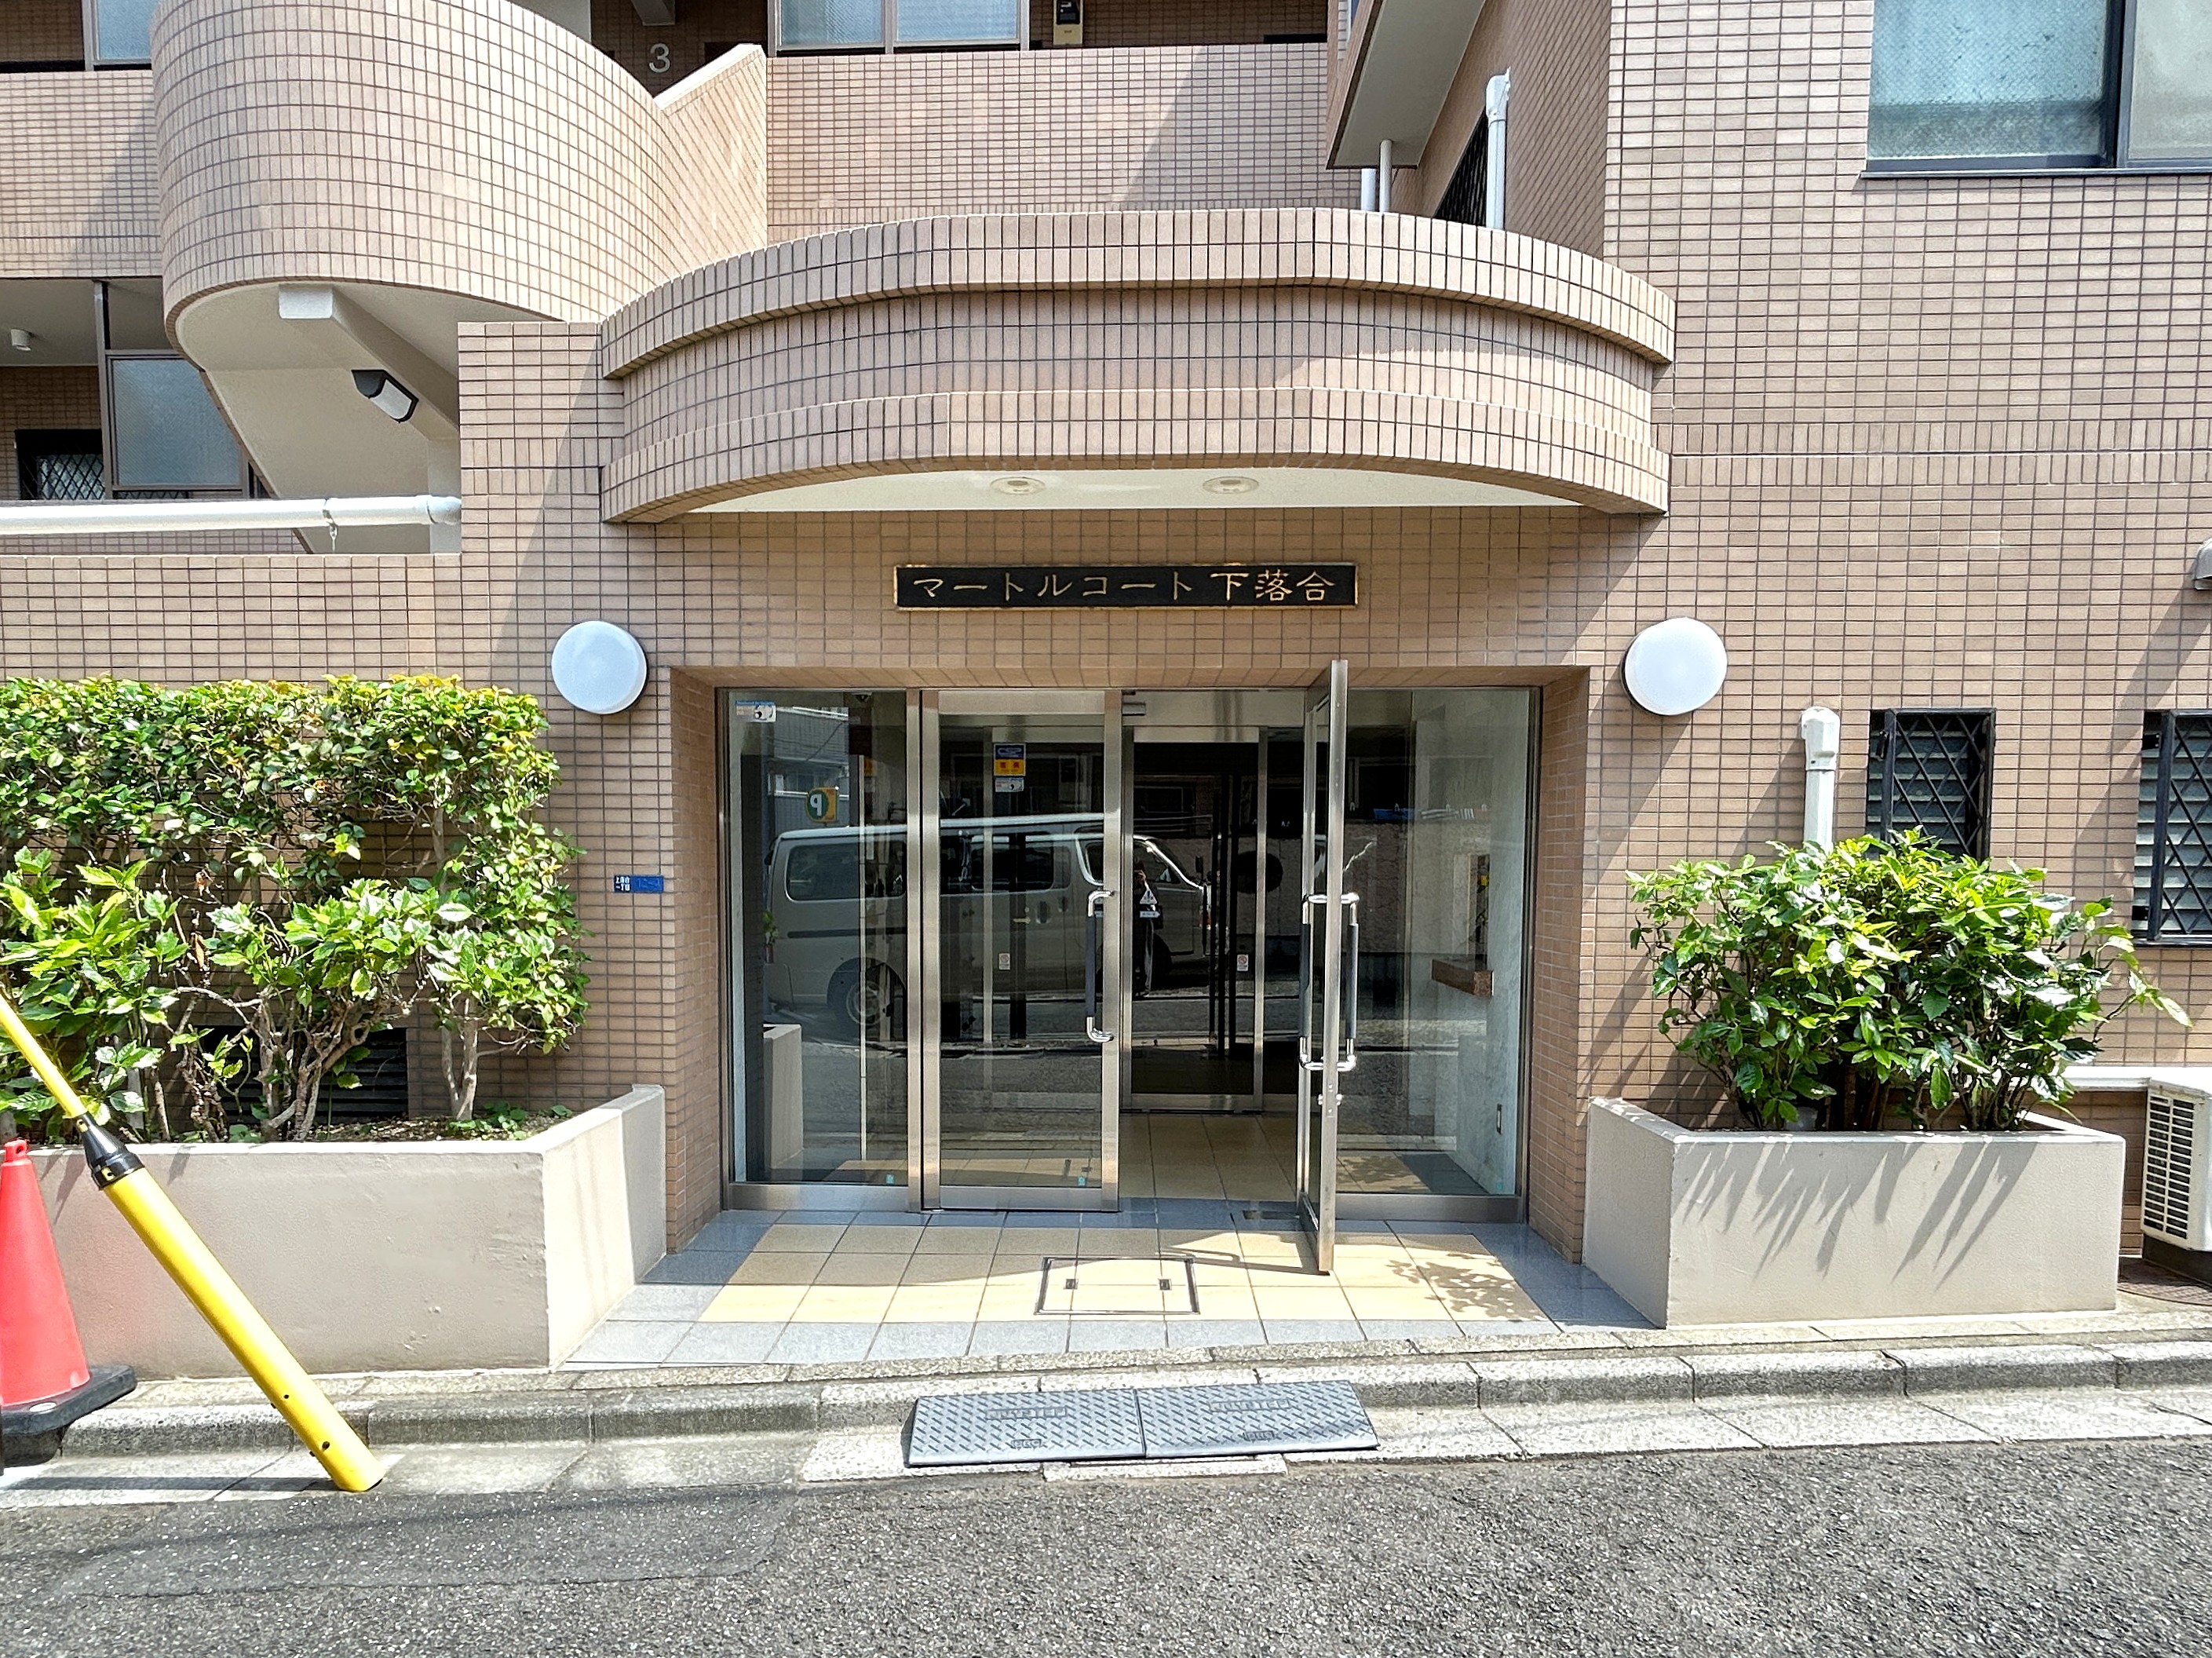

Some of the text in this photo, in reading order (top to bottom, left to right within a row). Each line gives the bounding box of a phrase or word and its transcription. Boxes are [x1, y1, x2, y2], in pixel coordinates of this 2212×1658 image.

[648, 42, 671, 73] 3
[913, 569, 1336, 602] マートルコート下落合
